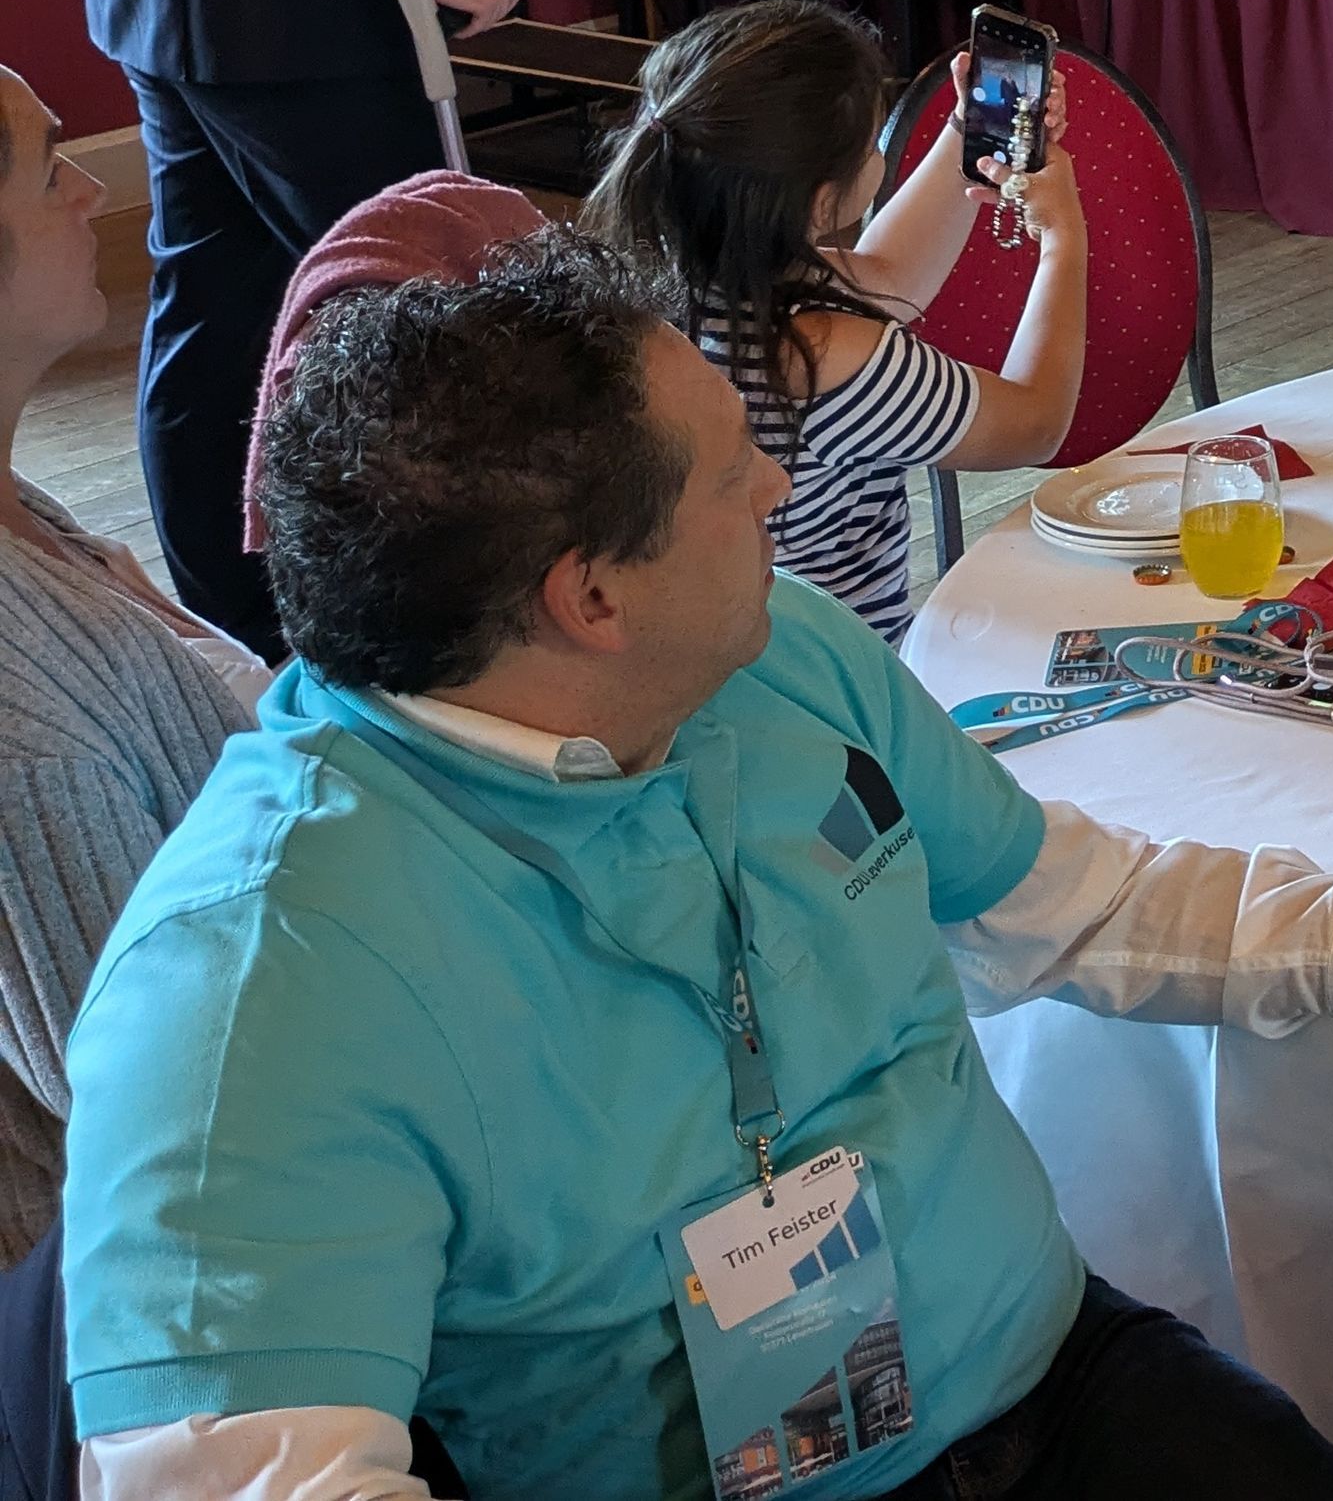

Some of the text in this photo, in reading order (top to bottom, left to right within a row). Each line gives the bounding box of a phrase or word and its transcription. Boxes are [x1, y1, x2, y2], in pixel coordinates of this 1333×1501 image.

[1010, 695, 1066, 714] CDU
[1039, 714, 1096, 736] CDU
[809, 1151, 842, 1177] CDU
[721, 1199, 838, 1269] Tim Feister
